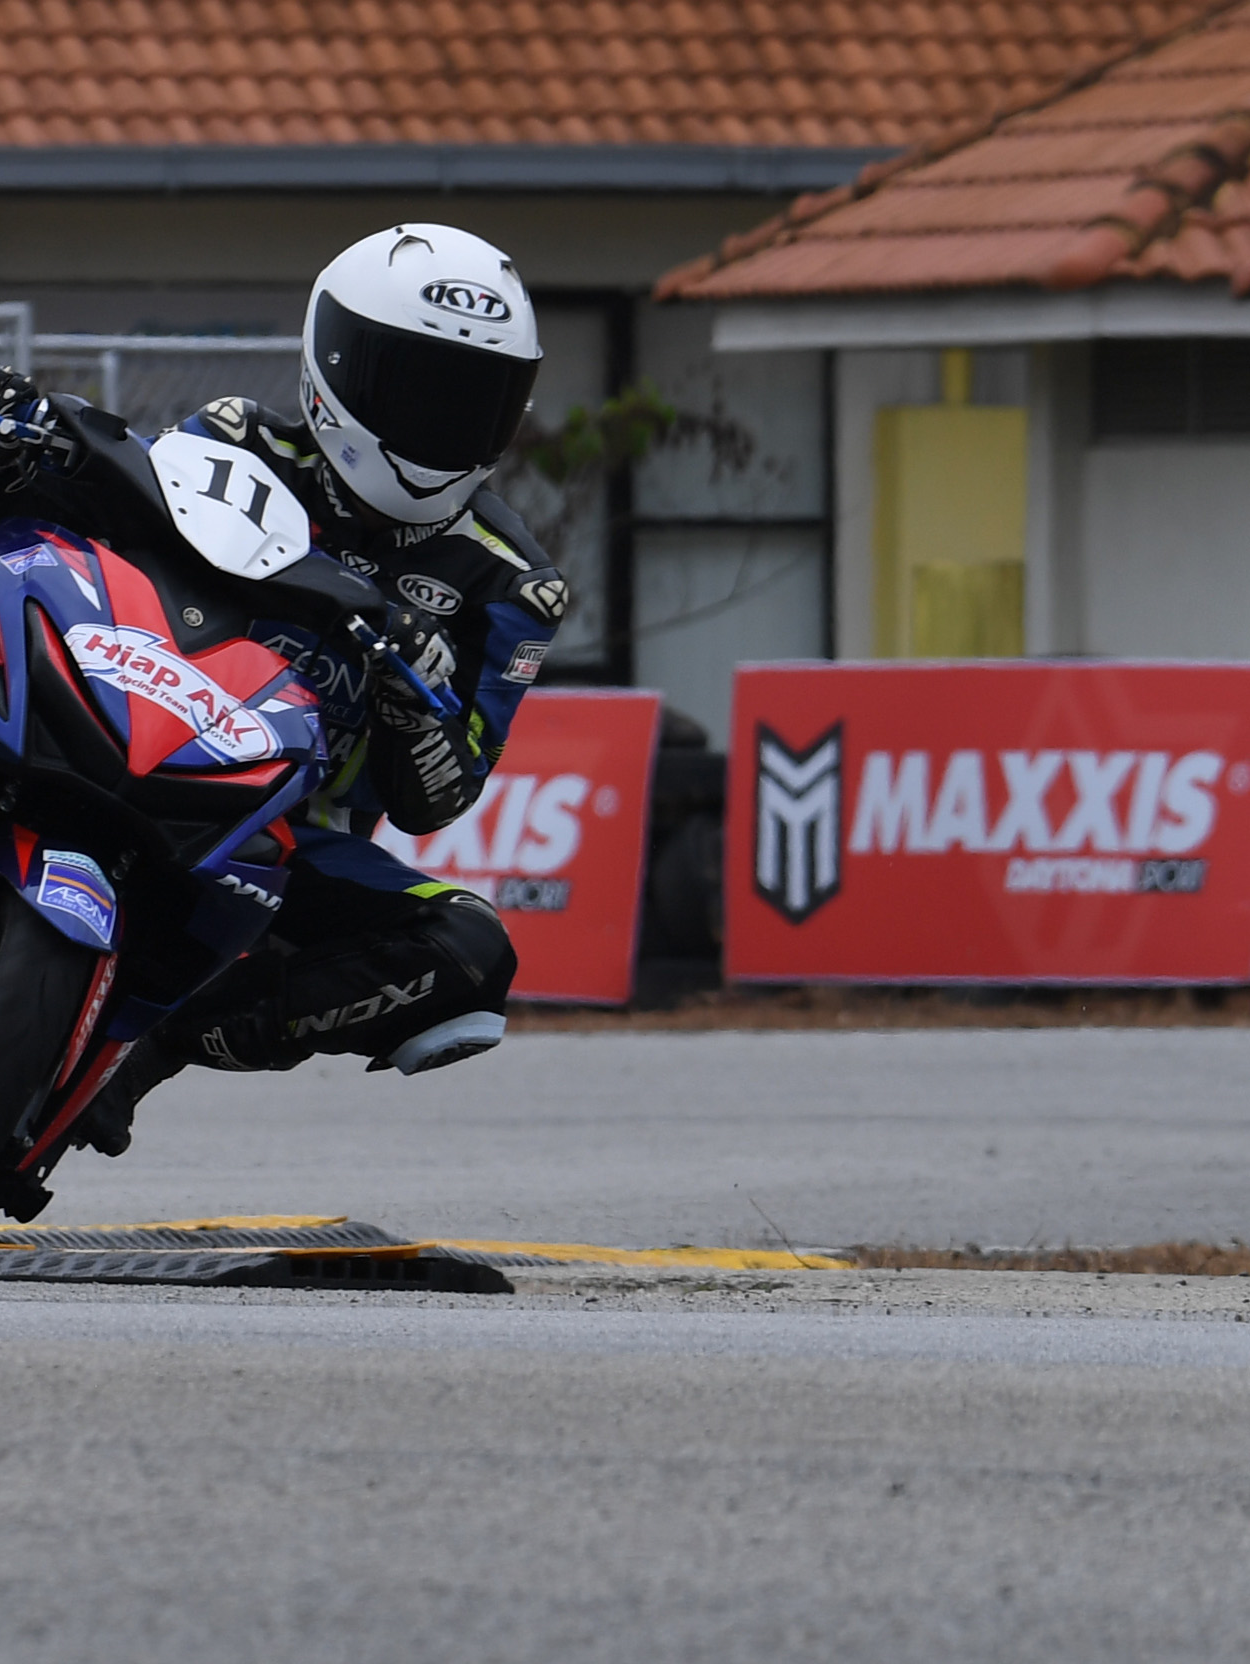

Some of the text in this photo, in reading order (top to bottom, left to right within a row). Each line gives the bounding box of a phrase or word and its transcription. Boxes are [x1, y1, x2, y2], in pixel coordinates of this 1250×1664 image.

[425, 283, 507, 317] KYT
[196, 456, 272, 535] 11
[401, 576, 458, 609] KYT
[84, 634, 181, 688] Hiap
[159, 690, 189, 714] Team
[849, 749, 1224, 855] MAXXIS
